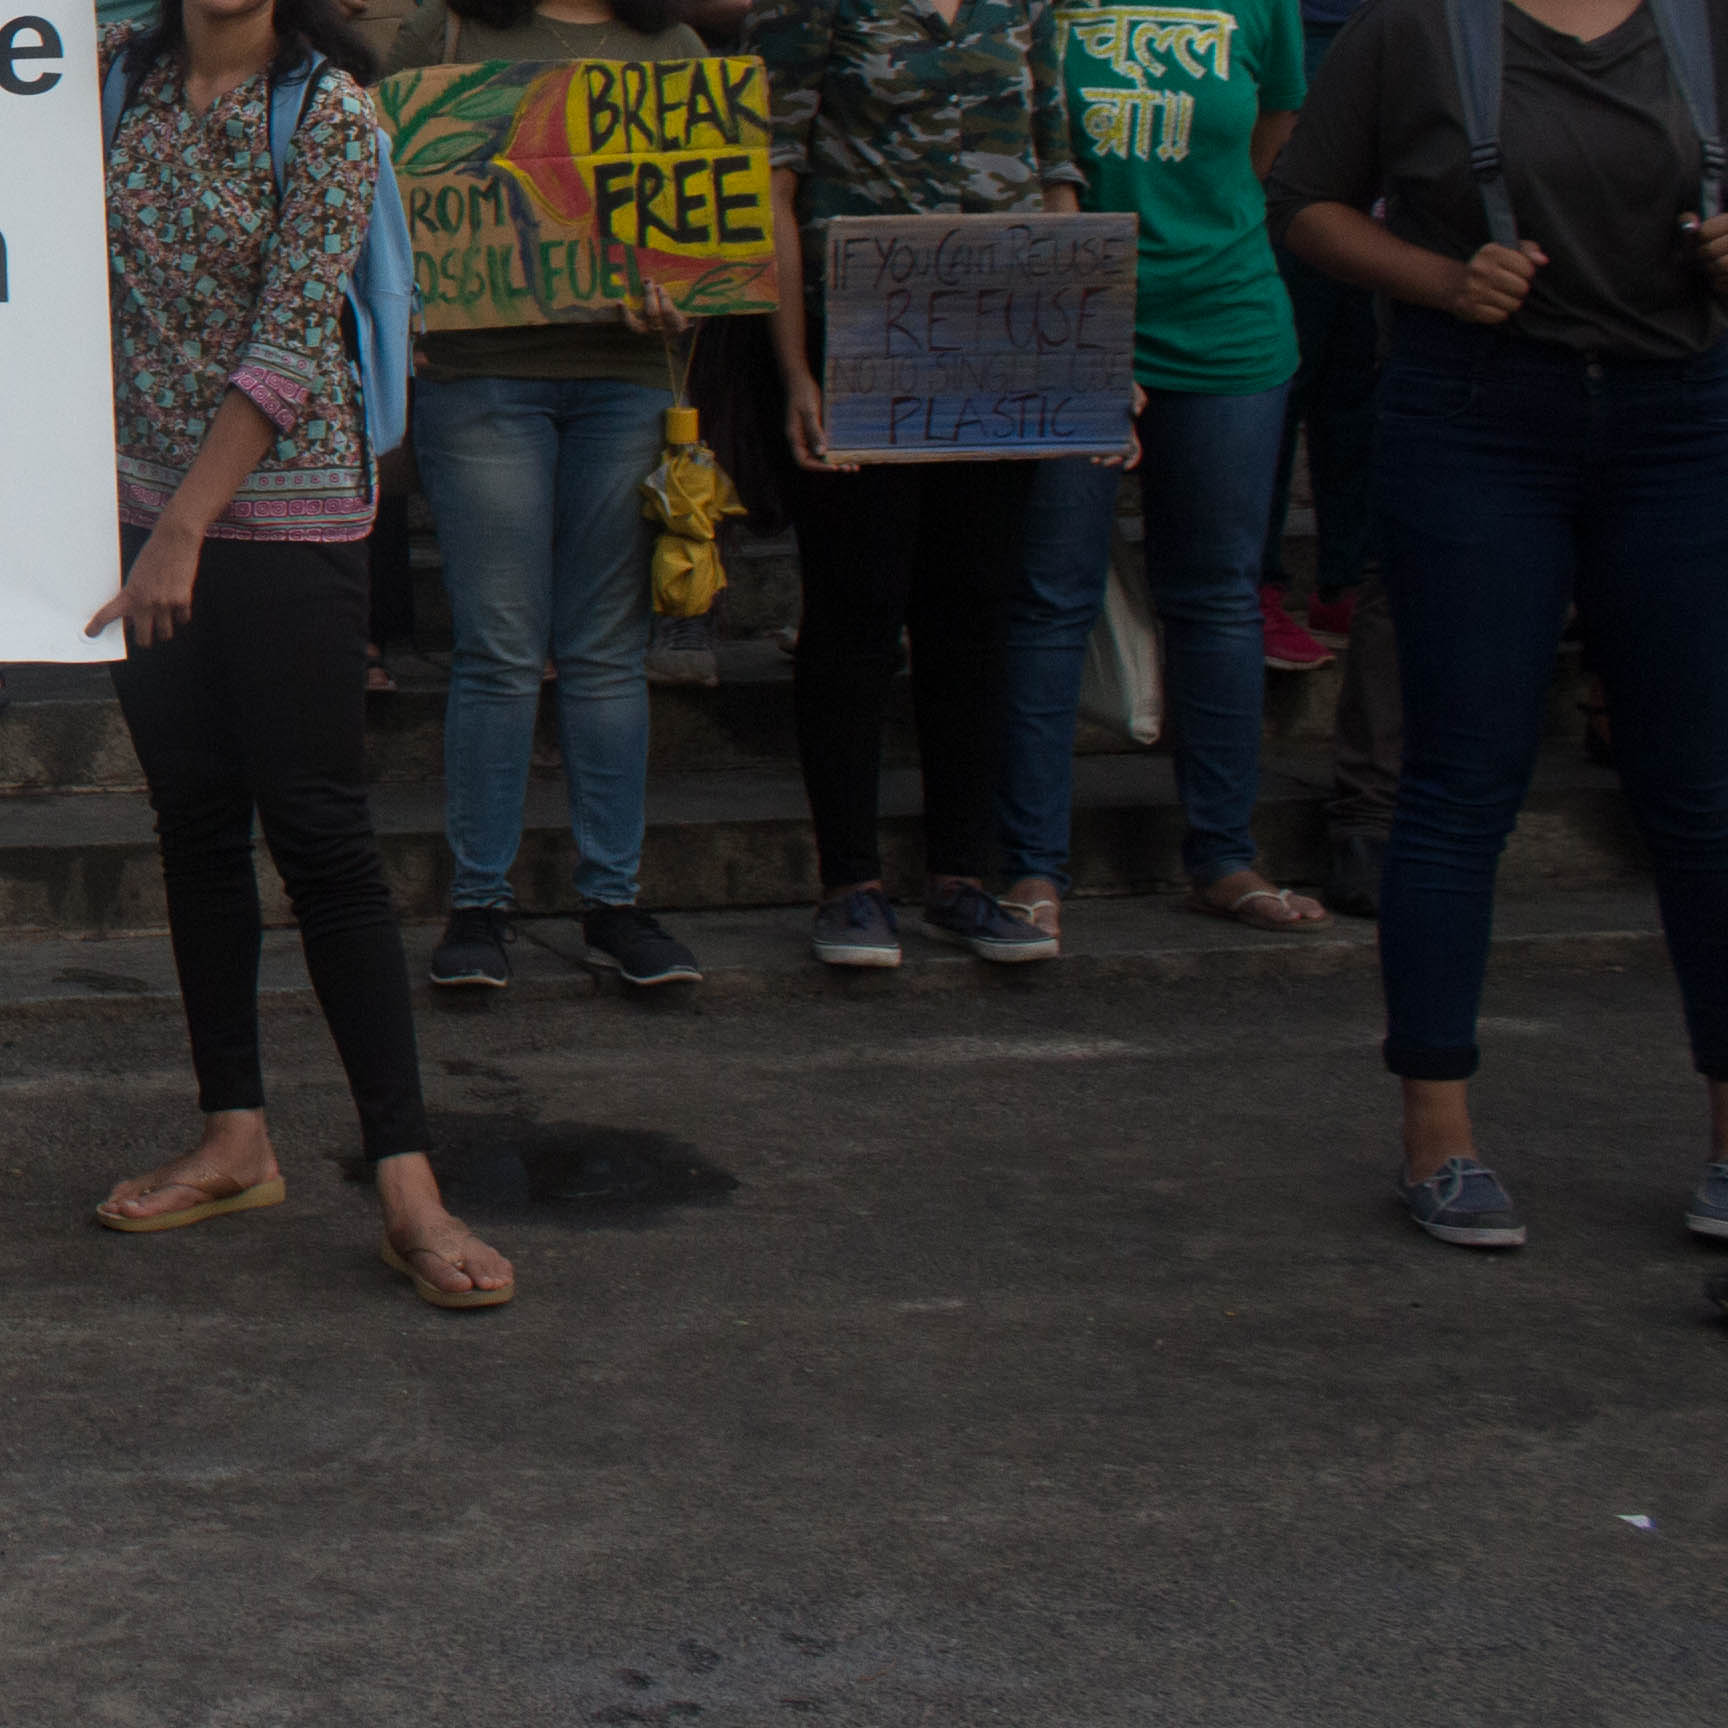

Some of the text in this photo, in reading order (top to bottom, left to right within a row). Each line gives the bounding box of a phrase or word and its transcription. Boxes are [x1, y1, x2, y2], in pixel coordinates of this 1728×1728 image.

[585, 59, 772, 154] BREAK
[410, 174, 506, 238] ROM
[593, 156, 766, 248] FREE
[414, 242, 530, 306] OSSIL
[884, 286, 1114, 356] REFUSE
[888, 392, 1076, 445] PLASTIC
